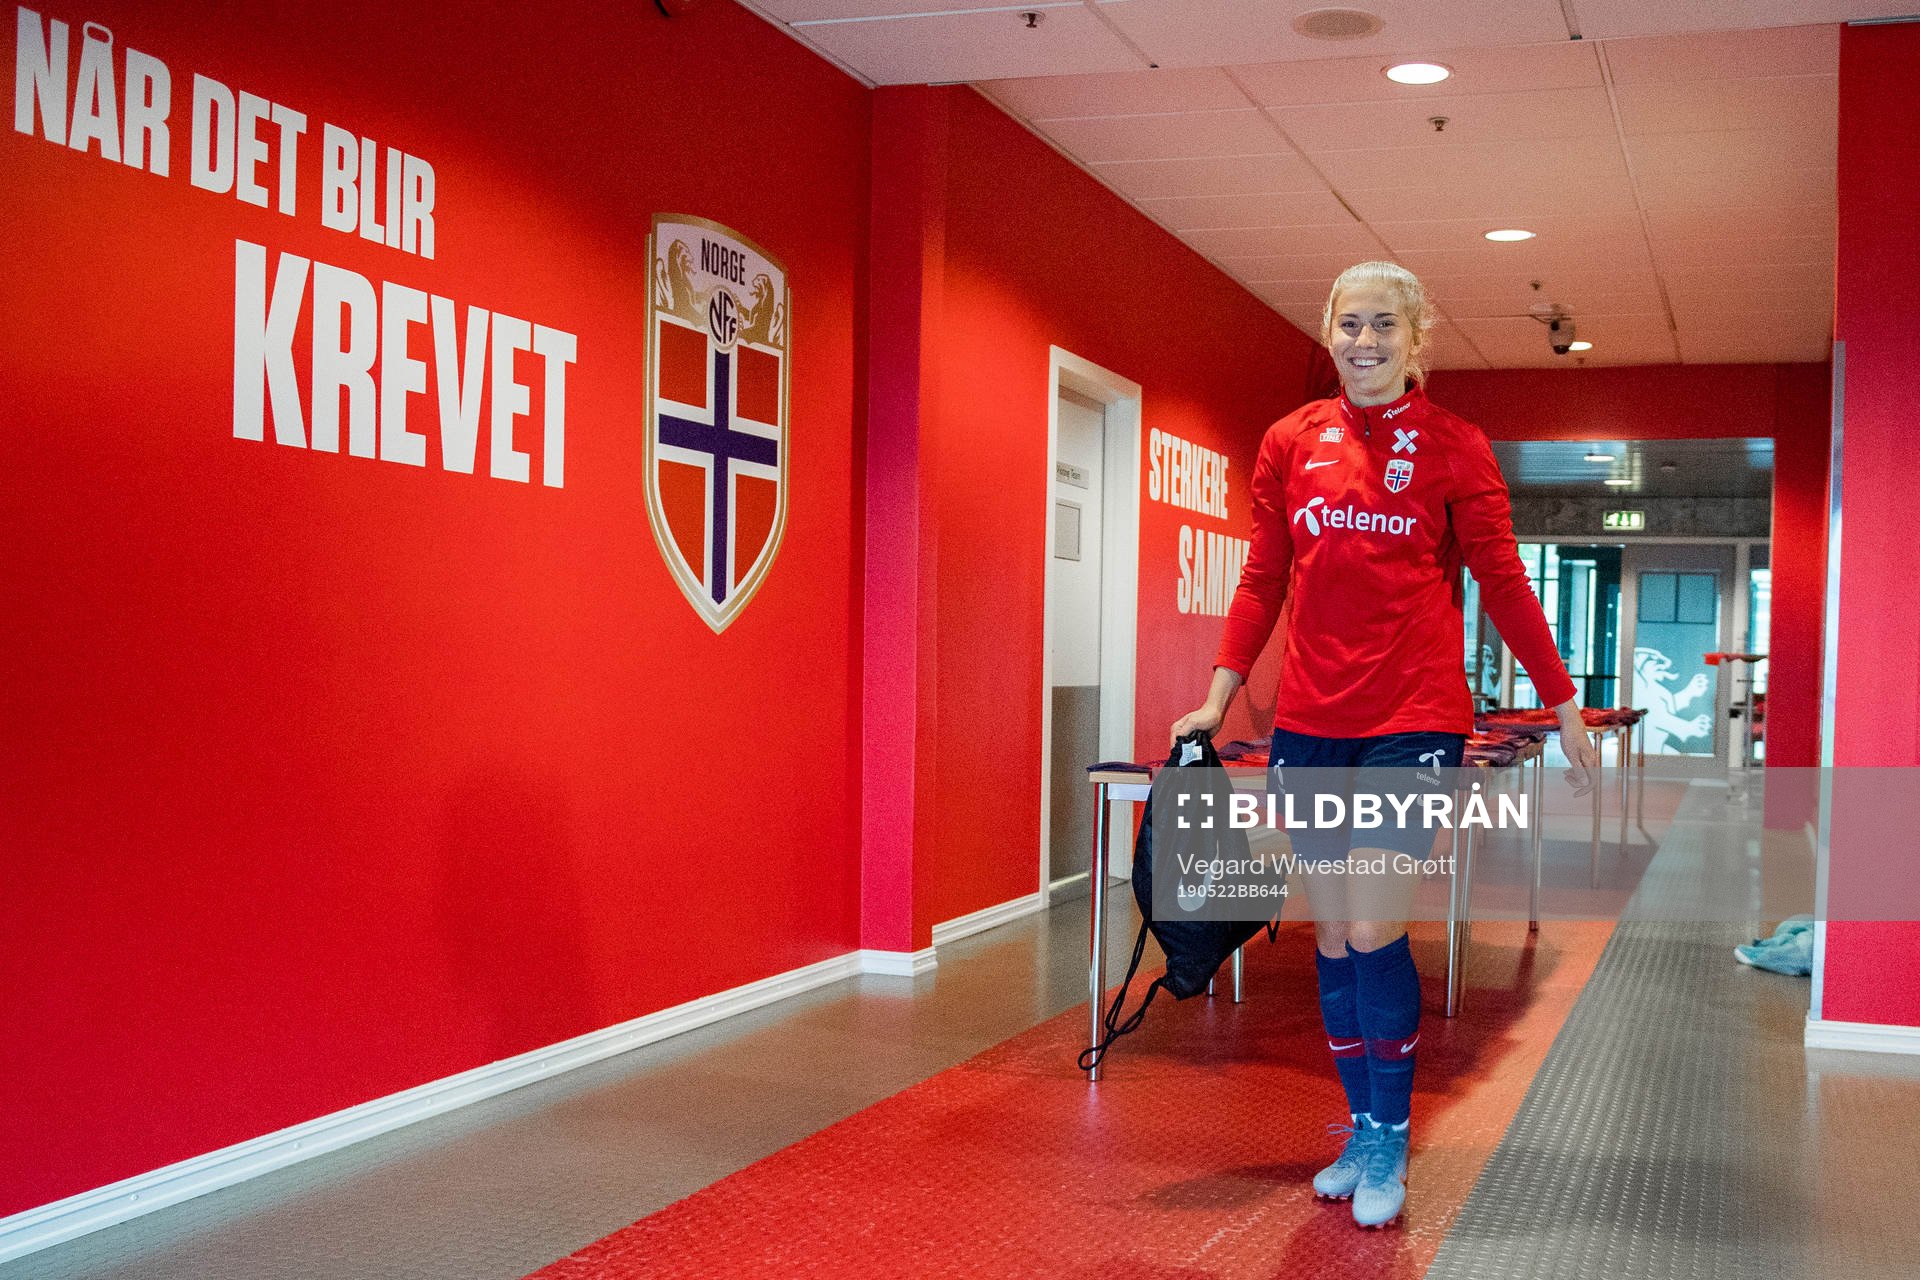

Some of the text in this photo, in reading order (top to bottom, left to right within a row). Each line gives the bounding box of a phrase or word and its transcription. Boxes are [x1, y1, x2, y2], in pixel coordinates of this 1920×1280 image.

[14, 5, 435, 260] NÅR DET BLIR
[701, 238, 746, 286] NORGE
[233, 238, 577, 489] KREVET
[1391, 402, 1411, 416] telenor
[1149, 427, 1229, 520] STERKERE
[1321, 505, 1417, 536] telenor
[1177, 524, 1251, 617] SAMM
[1416, 771, 1441, 786] telenor
